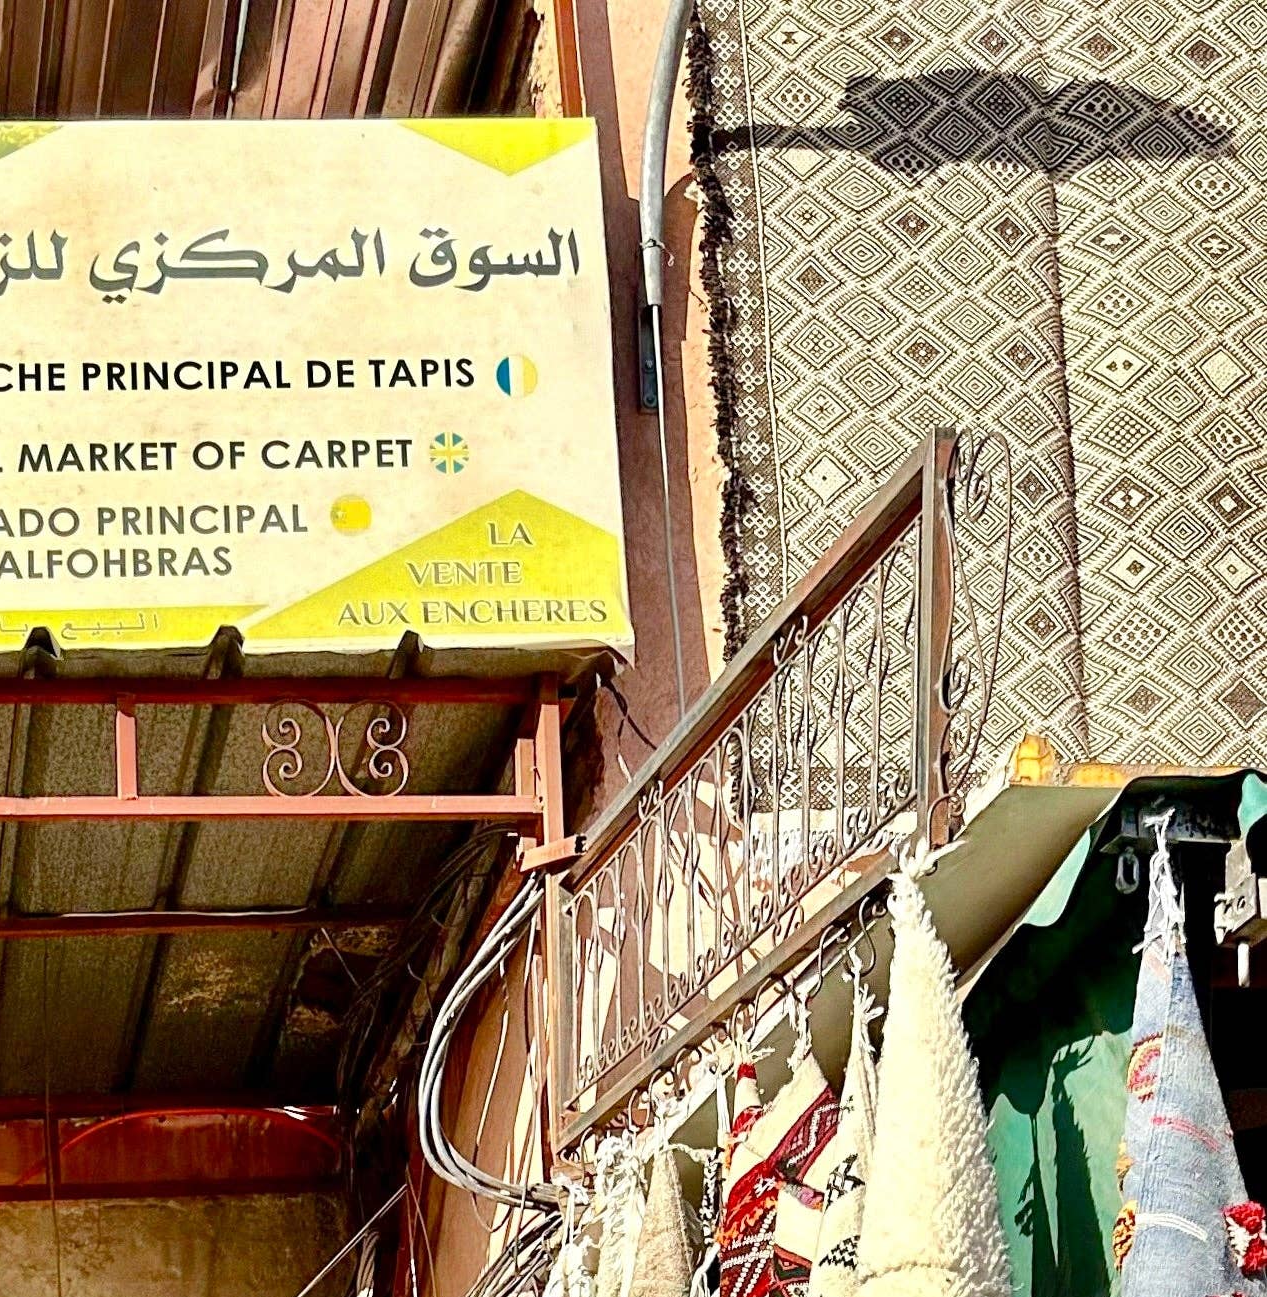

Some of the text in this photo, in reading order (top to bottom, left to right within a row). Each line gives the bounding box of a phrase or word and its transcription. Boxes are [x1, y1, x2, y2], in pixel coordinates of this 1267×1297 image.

[89, 227, 384, 304] المركزي
[409, 227, 579, 292] السوق
[83, 360, 291, 391] PRINCIPAL
[307, 360, 354, 388] DE
[368, 358, 475, 388] TAPIS
[18, 441, 177, 473] MARKET
[192, 440, 245, 471] OF
[261, 439, 413, 469] CARPET
[97, 504, 308, 536] PRINCIPAL
[488, 522, 533, 546] LA
[406, 561, 523, 585] VENTE
[60, 612, 158, 640] البيع
[338, 599, 608, 625] AUX ENCHERES
